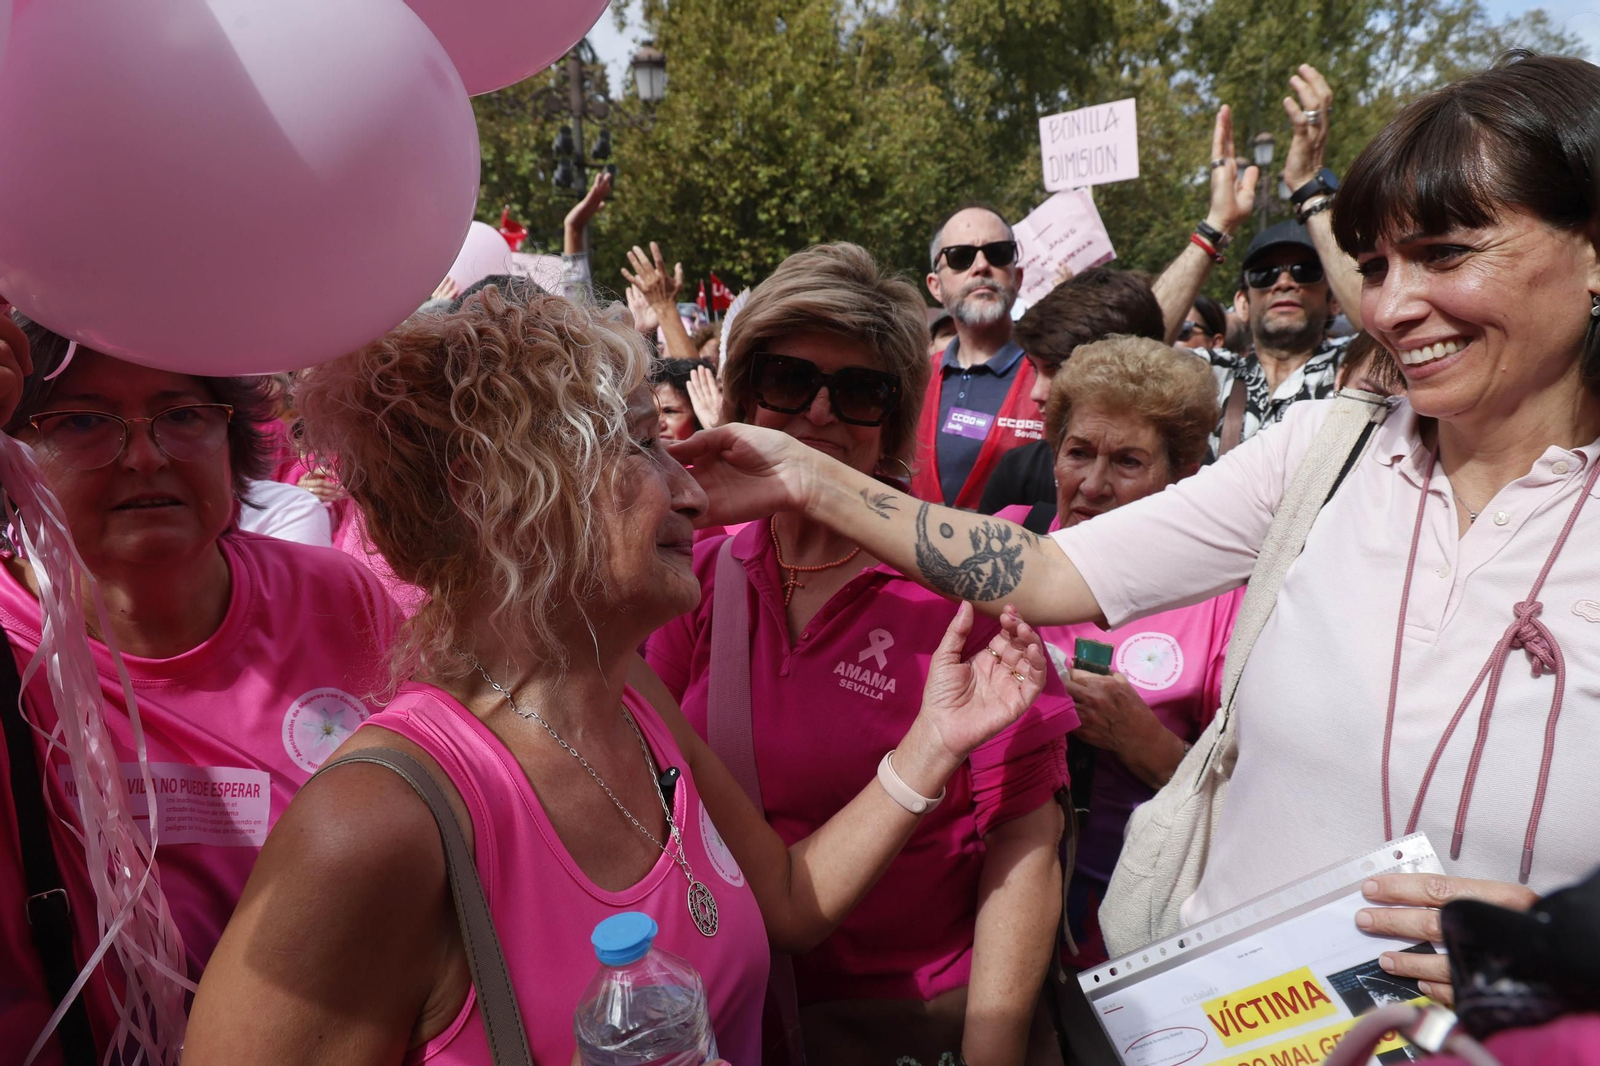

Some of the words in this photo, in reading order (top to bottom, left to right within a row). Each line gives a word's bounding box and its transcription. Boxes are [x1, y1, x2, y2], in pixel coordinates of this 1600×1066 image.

[1049, 106, 1120, 144] BONILLA
[997, 417, 1034, 429] CCOO
[1014, 429, 1042, 440] Sevilla
[833, 661, 896, 694] AMAMA
[839, 679, 884, 701] SEVILLA
[288, 719, 303, 758] Asociación
[298, 693, 325, 709] Mujeres
[160, 778, 178, 794] NO
[181, 779, 209, 797] PUEDE
[211, 782, 260, 798] ESPERAR
[1207, 980, 1332, 1038] VÍCTIMA
[1270, 1044, 1319, 1066] MAL
